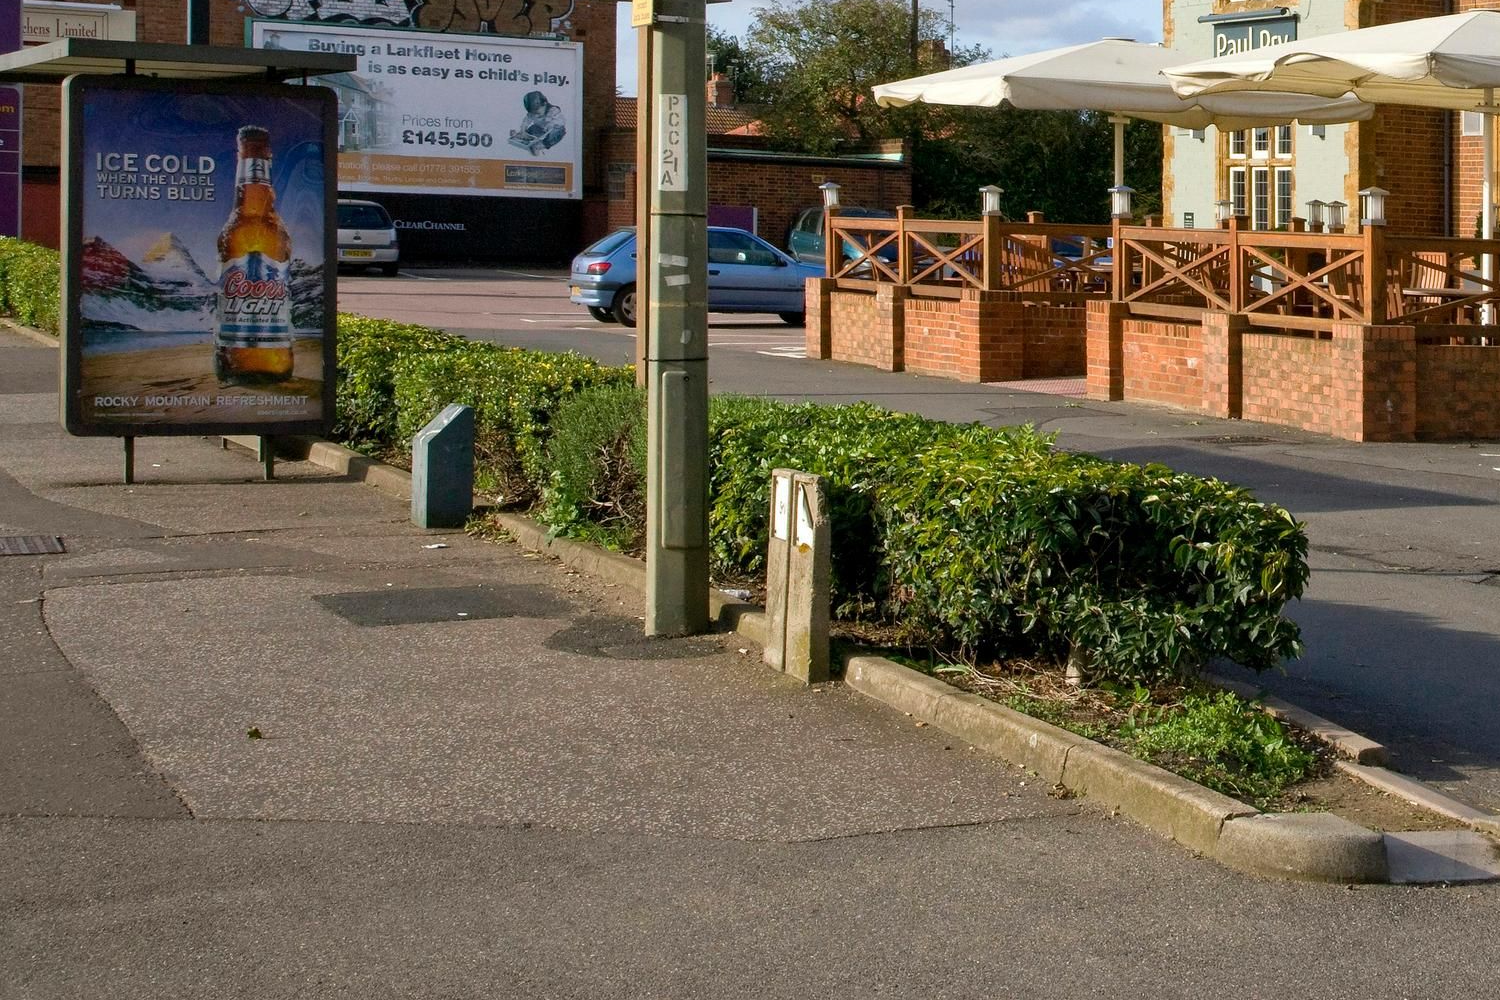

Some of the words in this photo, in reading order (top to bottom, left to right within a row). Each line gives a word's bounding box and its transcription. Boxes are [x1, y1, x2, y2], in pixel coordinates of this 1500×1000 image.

[22, 17, 50, 35] chens
[56, 18, 97, 38] Limited
[308, 38, 365, 55] Buying
[372, 45, 381, 55] a
[387, 43, 460, 60] Larkfleet
[465, 49, 512, 63] Home
[1216, 26, 1253, 57] Paul
[368, 60, 382, 73] is
[387, 64, 407, 75] as
[412, 66, 450, 79] easy
[454, 68, 474, 79] as
[479, 67, 529, 82] child's
[534, 70, 569, 86] play.
[402, 114, 441, 128] Prices
[445, 116, 473, 129] from
[402, 130, 493, 149] £145,500
[96, 153, 138, 172] ICE
[146, 154, 216, 175] COLD
[372, 162, 401, 173] please
[403, 163, 417, 173] call
[96, 173, 138, 184] WHEN
[141, 174, 167, 185] THE
[172, 176, 214, 187] LABEL
[96, 185, 161, 199] TURNS
[167, 187, 216, 201] BLUE
[224, 270, 286, 298] Coors
[224, 298, 284, 314] LIGHT
[94, 396, 139, 407] ROCKY
[145, 395, 210, 407] MOUNTAIN
[216, 394, 308, 406] REFRESHMENT
